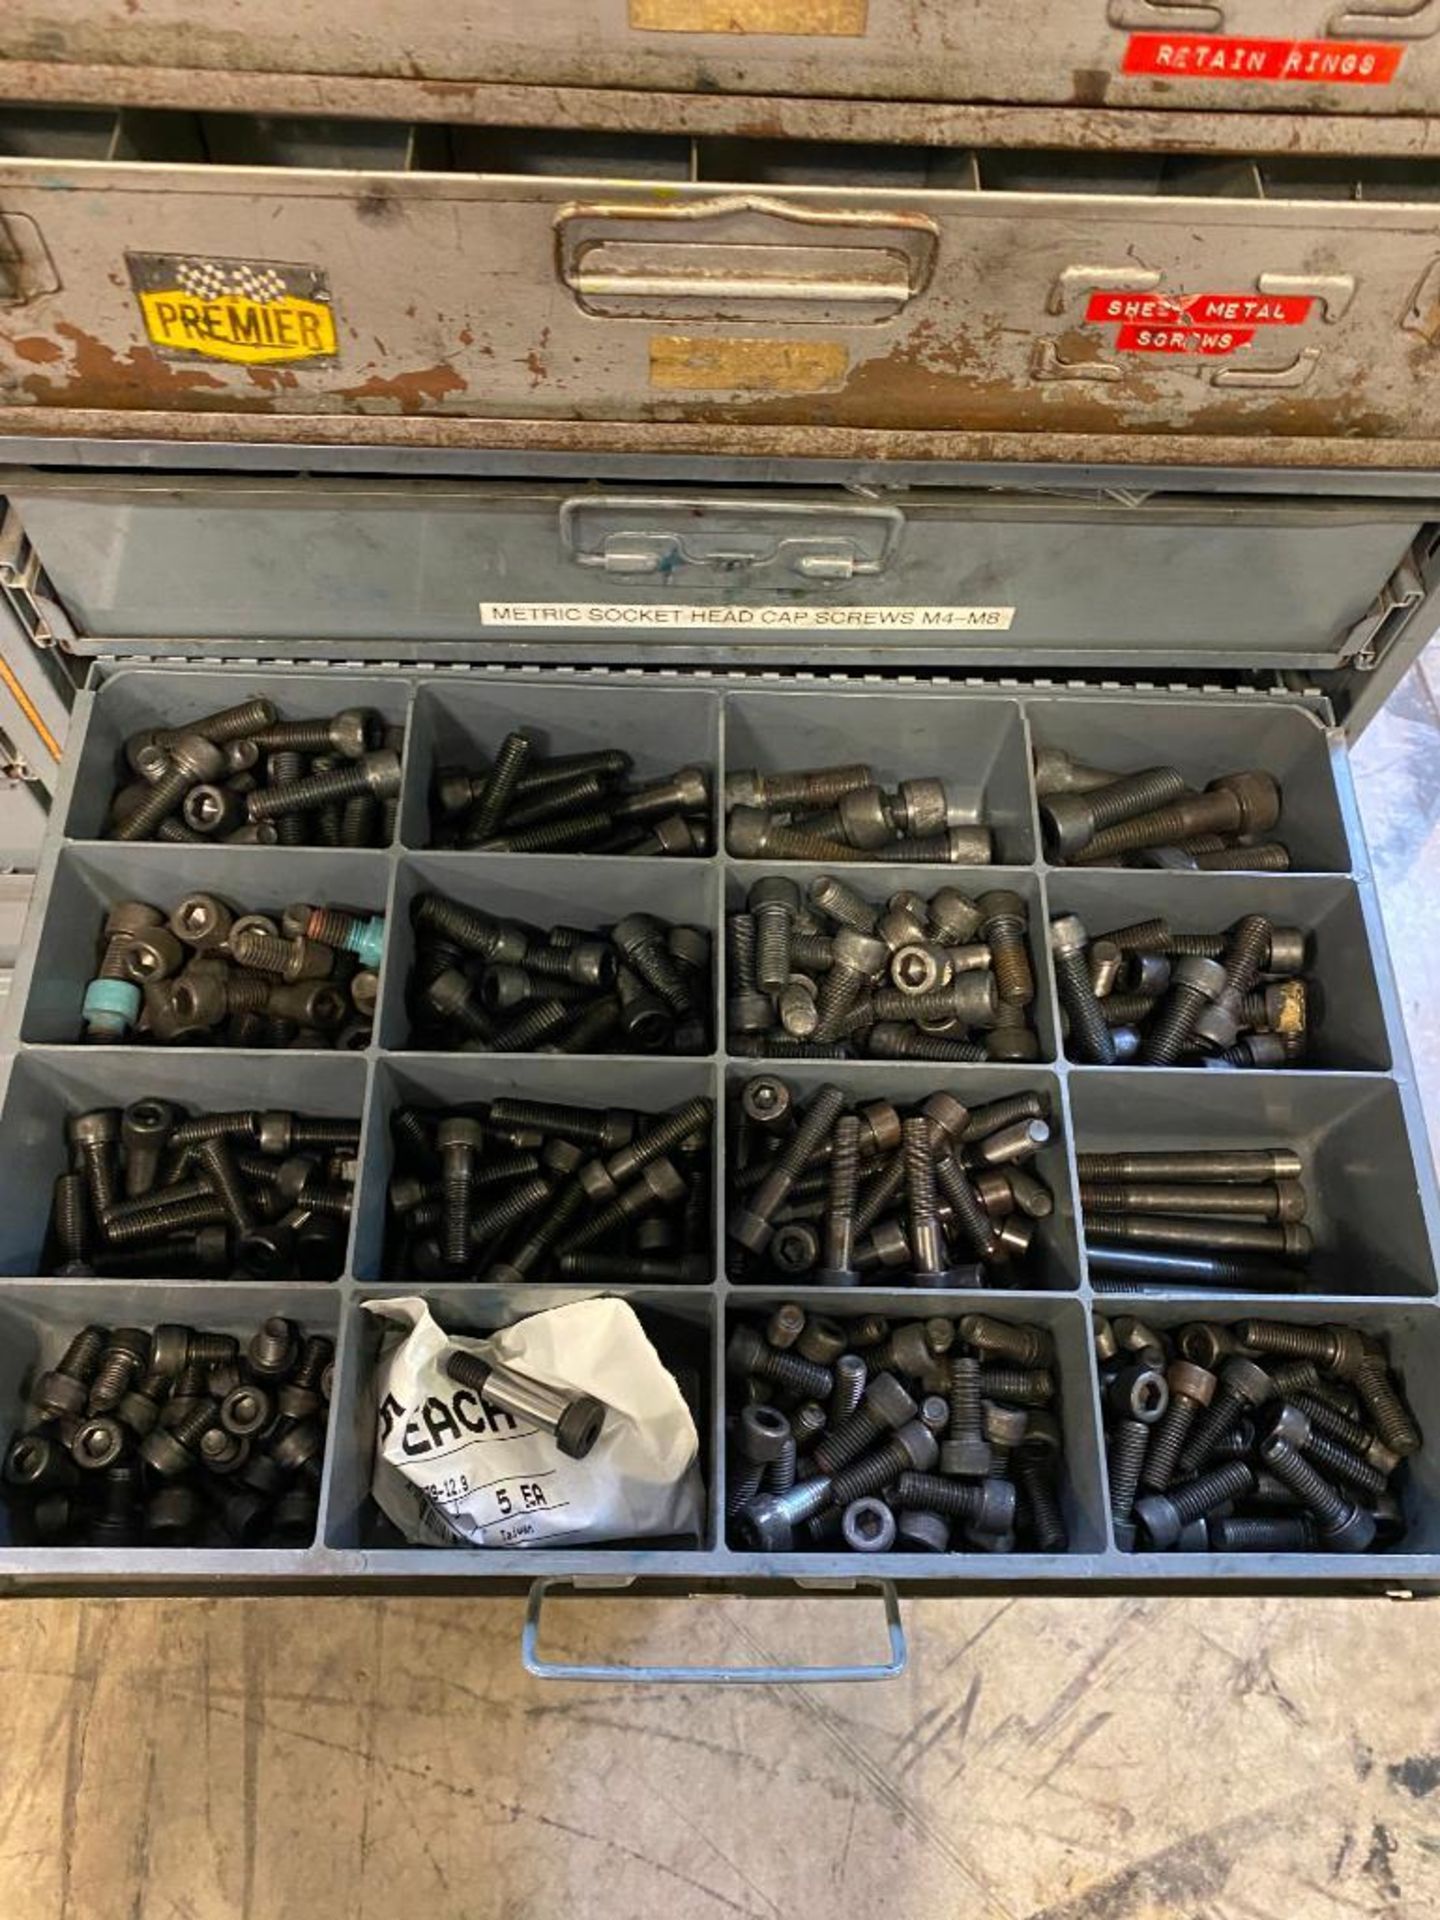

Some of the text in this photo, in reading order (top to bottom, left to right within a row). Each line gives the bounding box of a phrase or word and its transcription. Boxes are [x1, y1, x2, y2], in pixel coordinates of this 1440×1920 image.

[1155, 44, 1376, 75] RETAIN RINGS
[1205, 302, 1286, 319] METAL
[154, 301, 324, 350] PREMIER
[1136, 331, 1234, 349] SCRWS
[492, 607, 582, 621] METRIC
[588, 608, 682, 623] SOCKET
[691, 609, 754, 623] HEAD
[761, 610, 808, 625] CAP
[815, 611, 915, 625] SCREWS
[402, 1389, 517, 1456] EACH
[495, 1482, 548, 1514] 5 EA
[500, 1524, 535, 1541] Taiwan
